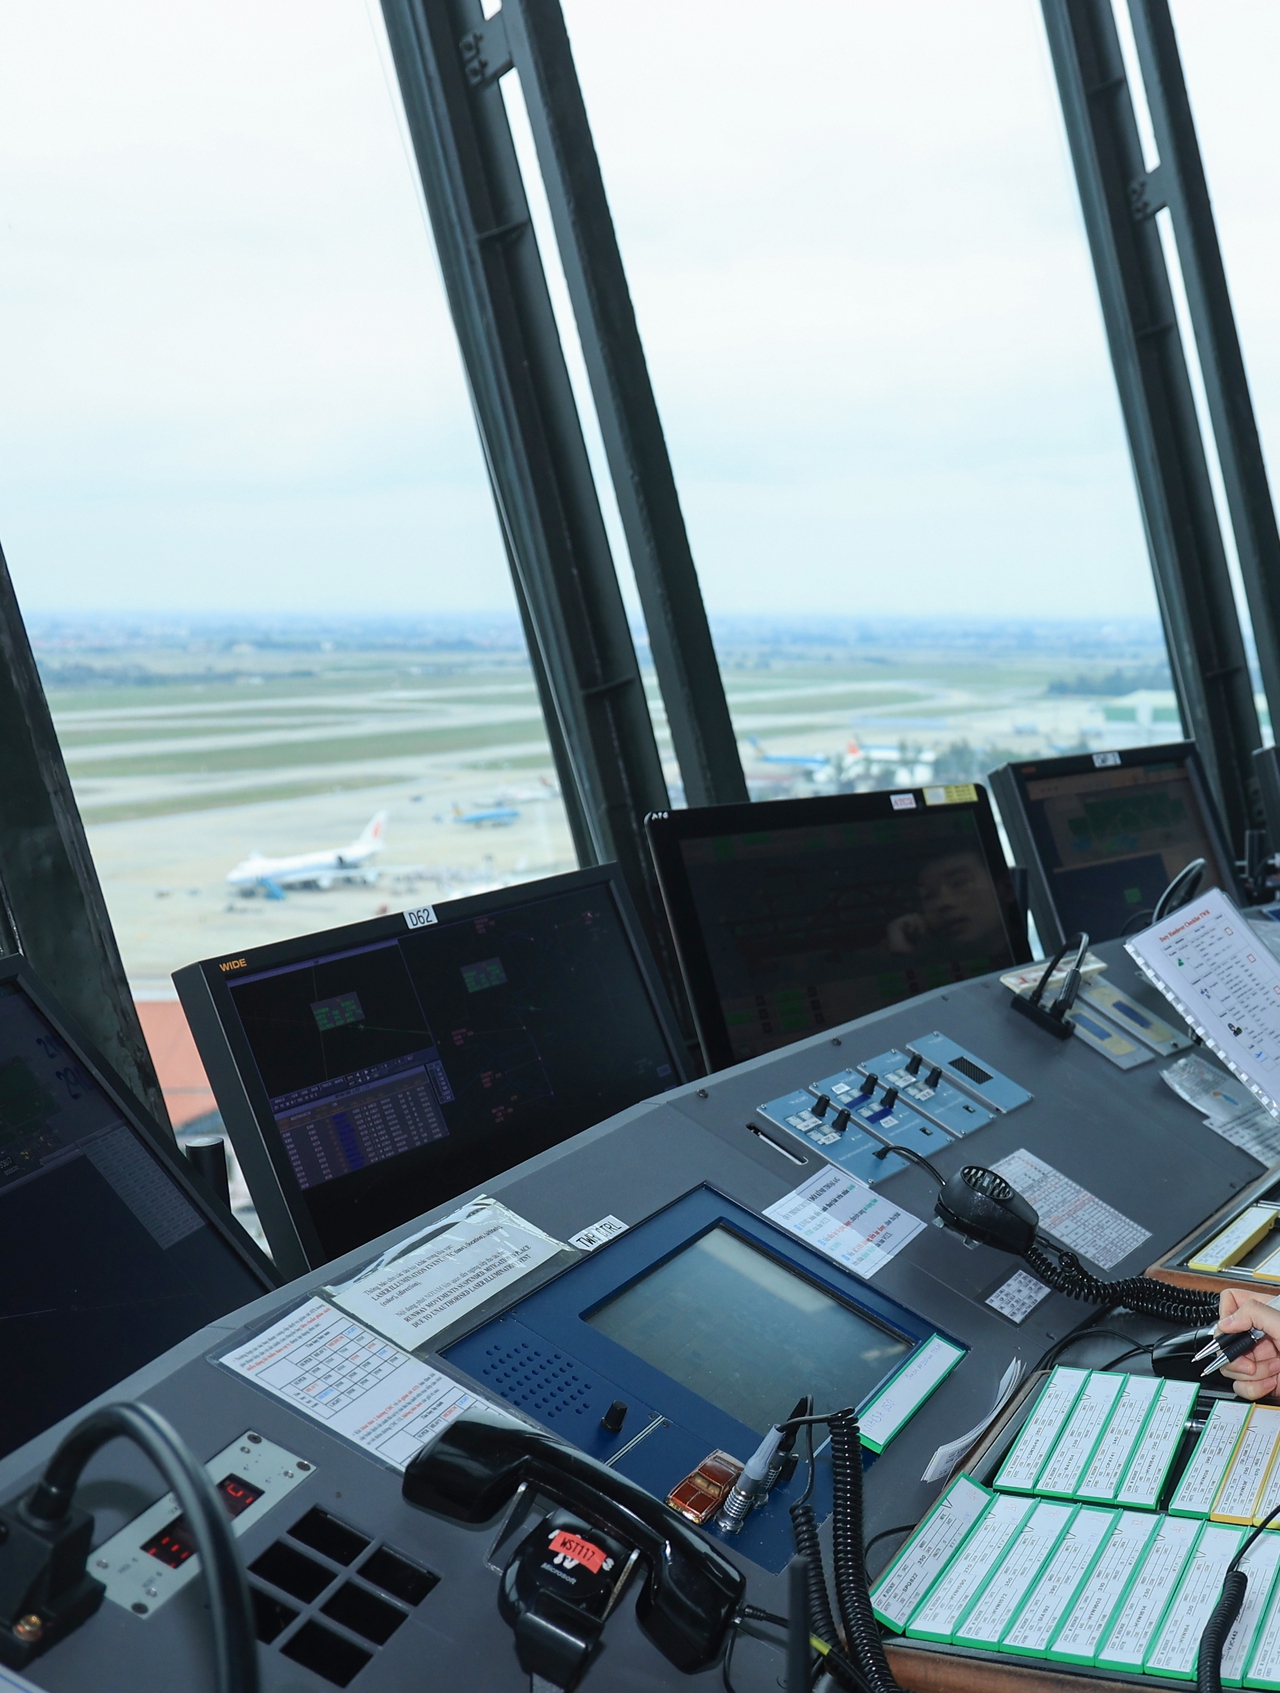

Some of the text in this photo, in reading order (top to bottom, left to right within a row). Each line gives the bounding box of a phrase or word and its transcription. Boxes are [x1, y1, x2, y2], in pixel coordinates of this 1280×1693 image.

[409, 908, 433, 927] D62
[219, 958, 247, 972] WIDE
[576, 1221, 622, 1248] TWR CTRL
[559, 1537, 596, 1562] WST117
[916, 1554, 927, 1564] 350
[540, 1562, 577, 1585] Microsoft
[963, 1563, 973, 1573] 270
[1142, 1587, 1151, 1597] 230
[1186, 1604, 1194, 1615] 230
[1227, 1630, 1238, 1649] VJC442
